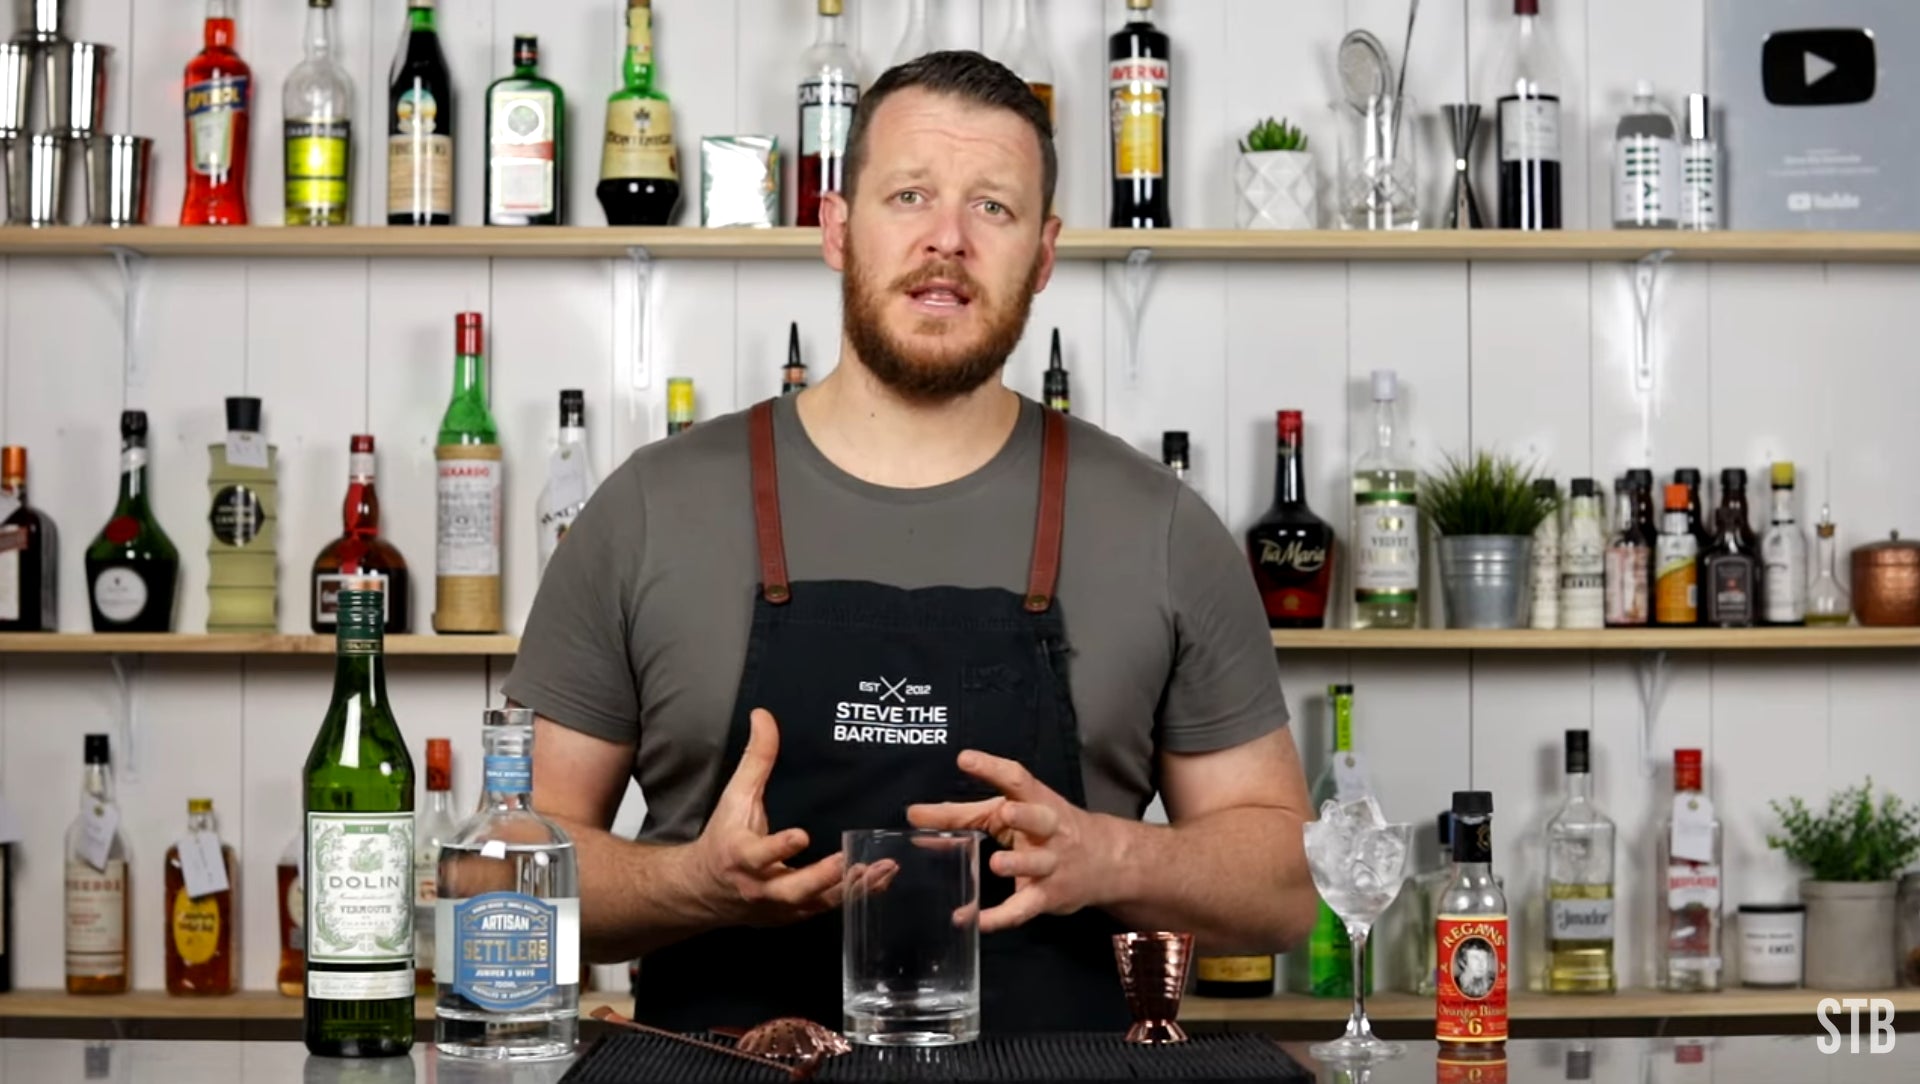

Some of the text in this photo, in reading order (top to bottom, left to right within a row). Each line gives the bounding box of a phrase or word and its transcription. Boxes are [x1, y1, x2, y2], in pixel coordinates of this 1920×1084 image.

[1112, 66, 1166, 80] AVERNA
[859, 681, 931, 695] EST 2012
[836, 702, 948, 723] STEVE THE
[834, 725, 947, 744] BARTENDER
[329, 876, 399, 888] DOLIN
[481, 914, 530, 931] ARTISAN
[463, 939, 548, 962] SETTLERS
[1468, 1017, 1483, 1036] 6
